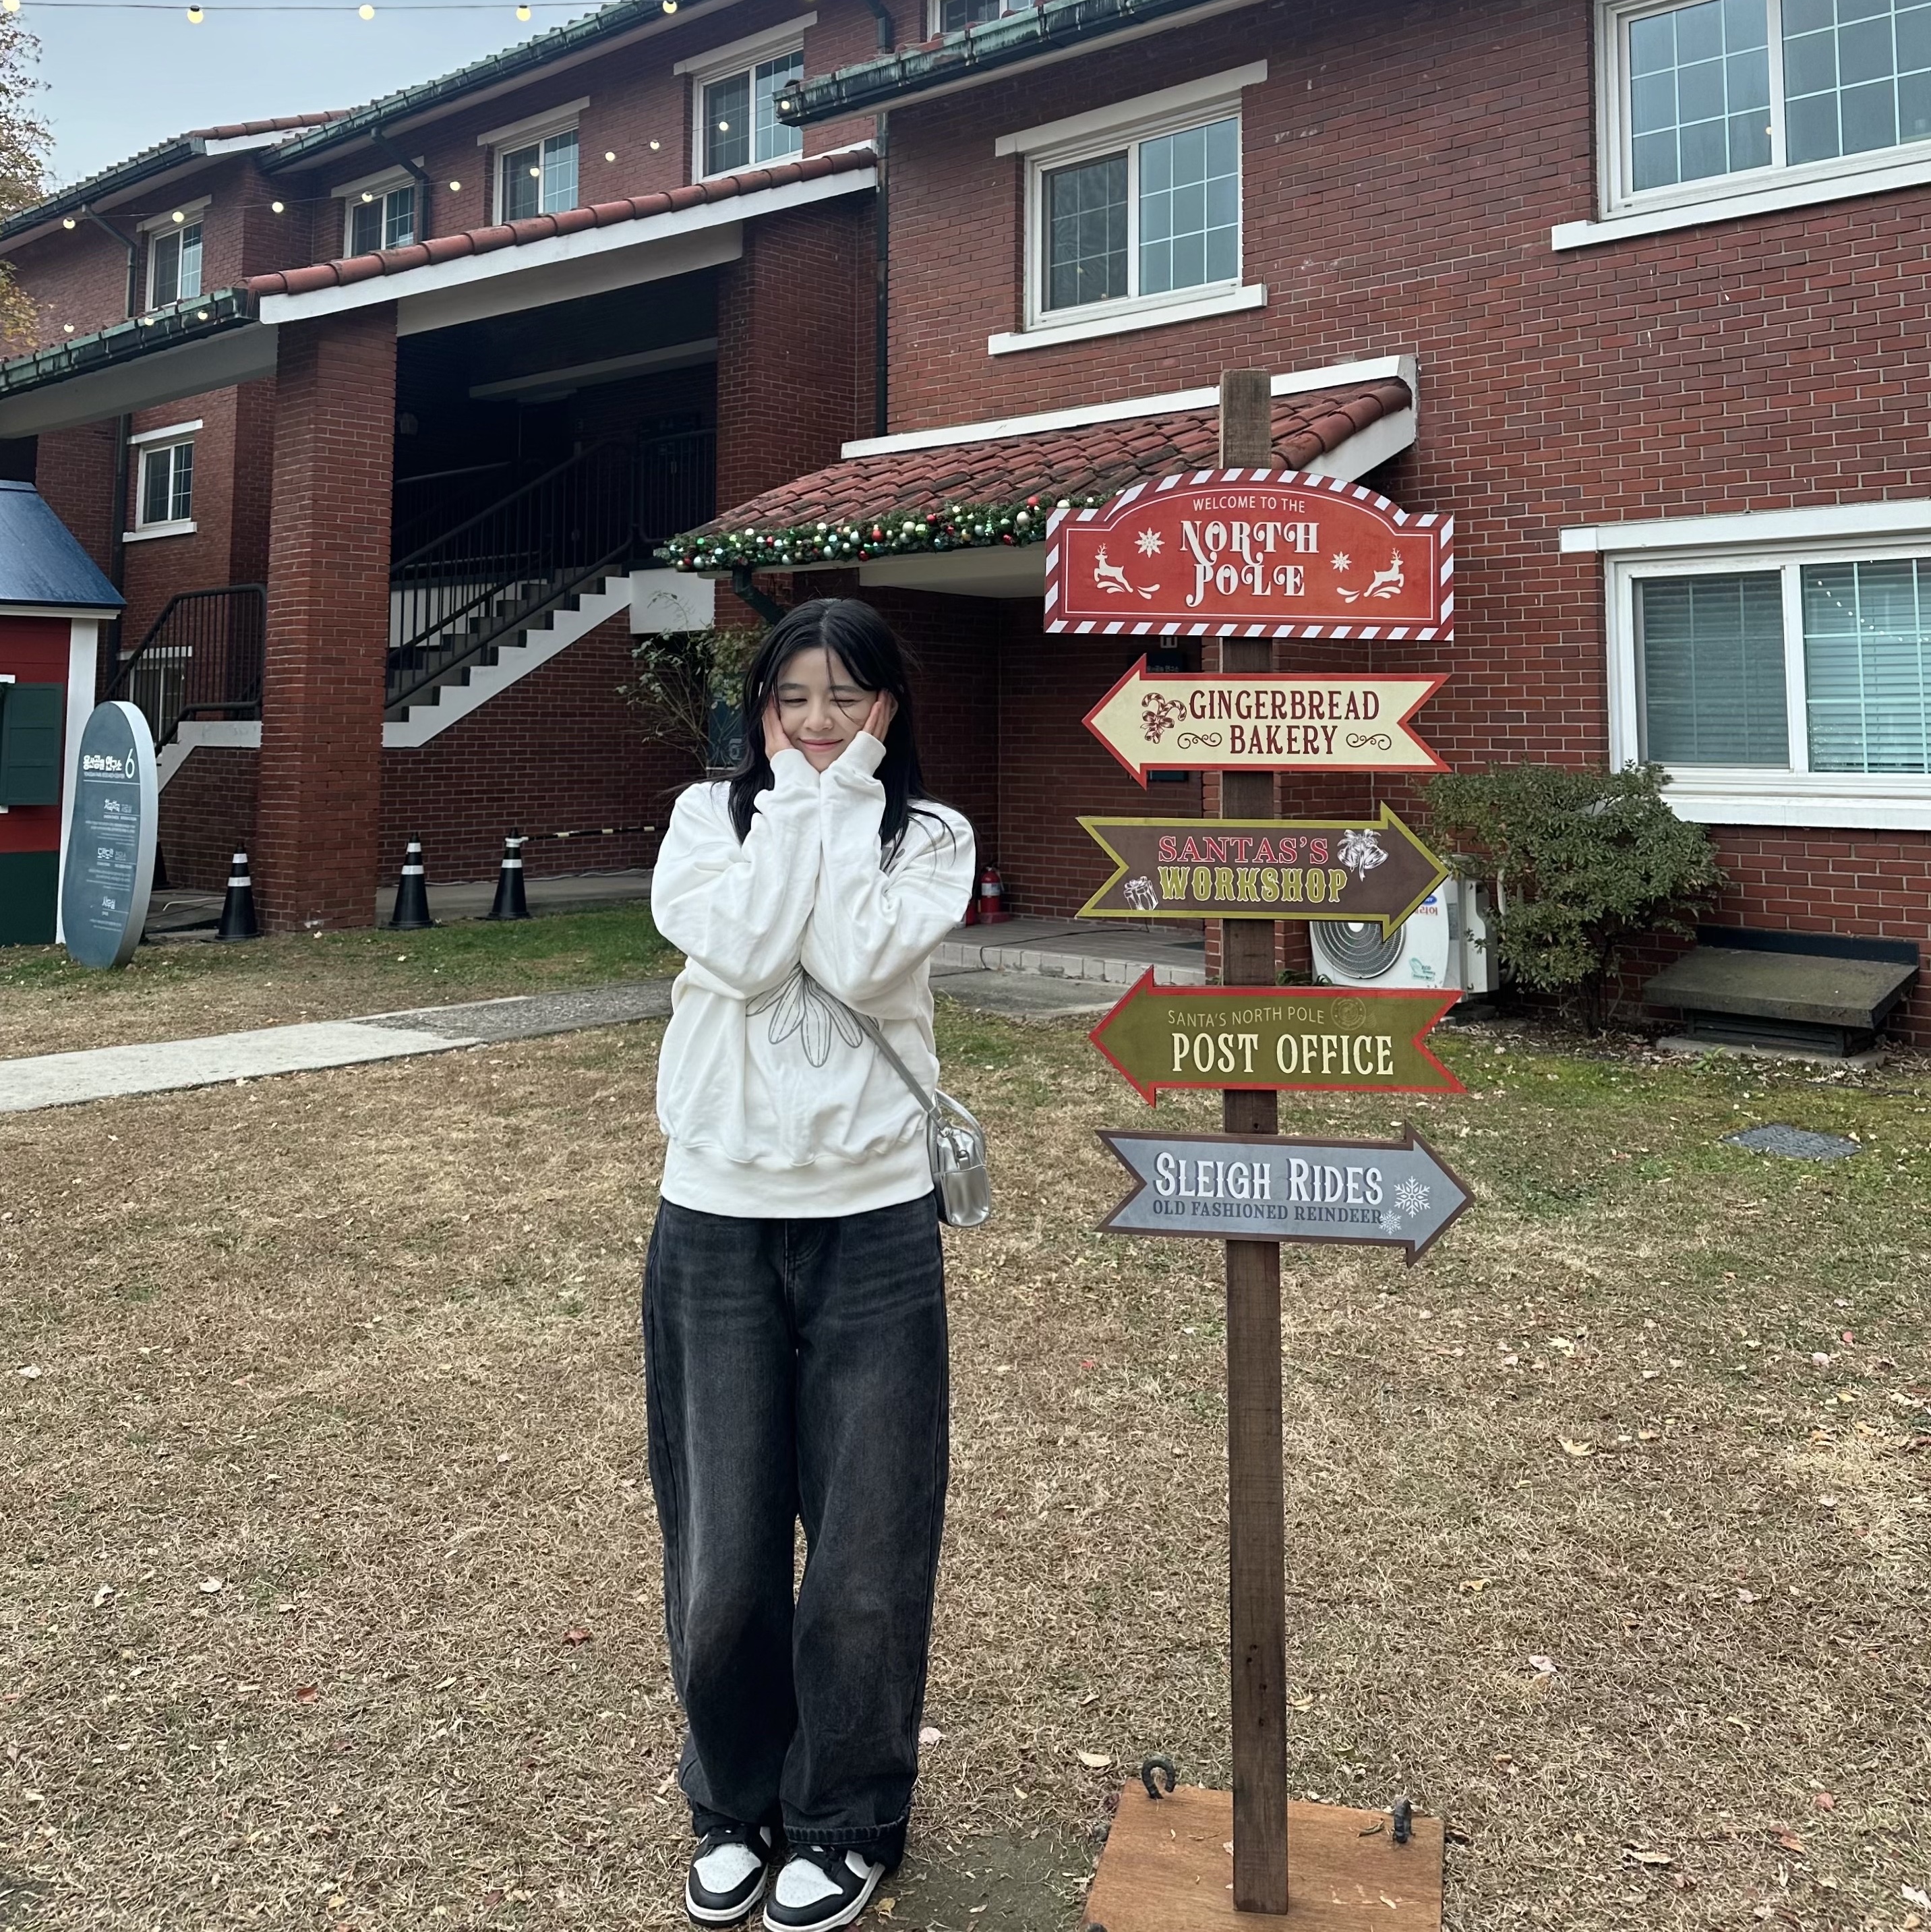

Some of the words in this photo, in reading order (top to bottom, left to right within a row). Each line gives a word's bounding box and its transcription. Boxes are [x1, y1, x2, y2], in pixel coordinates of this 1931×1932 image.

[1193, 496, 1256, 513] WELCOME
[1259, 496, 1278, 510] TO
[1281, 498, 1305, 513] THE
[1180, 520, 1319, 565] NORTH
[1185, 563, 1305, 608] POLE
[1189, 690, 1380, 721] GINGERBREAD
[1230, 725, 1338, 755] BAKERY
[83, 755, 105, 771] 용산공원
[105, 755, 123, 771] 연구소
[125, 748, 135, 779] 6
[1158, 836, 1329, 865] SANTAS'S
[1156, 865, 1348, 904] WORKSHOP
[1168, 1009, 1227, 1028] SANTA'S
[1232, 1007, 1282, 1025] NORTH
[1288, 1006, 1325, 1025] POLE
[1170, 1032, 1259, 1074] POST
[1276, 1033, 1394, 1076] OFFICE
[1154, 1151, 1272, 1200] SLEIGH
[1286, 1157, 1384, 1206] RIDES
[1152, 1199, 1185, 1216] OLD
[1191, 1200, 1288, 1221] FASHIONED
[1294, 1206, 1383, 1225] REINDEER
